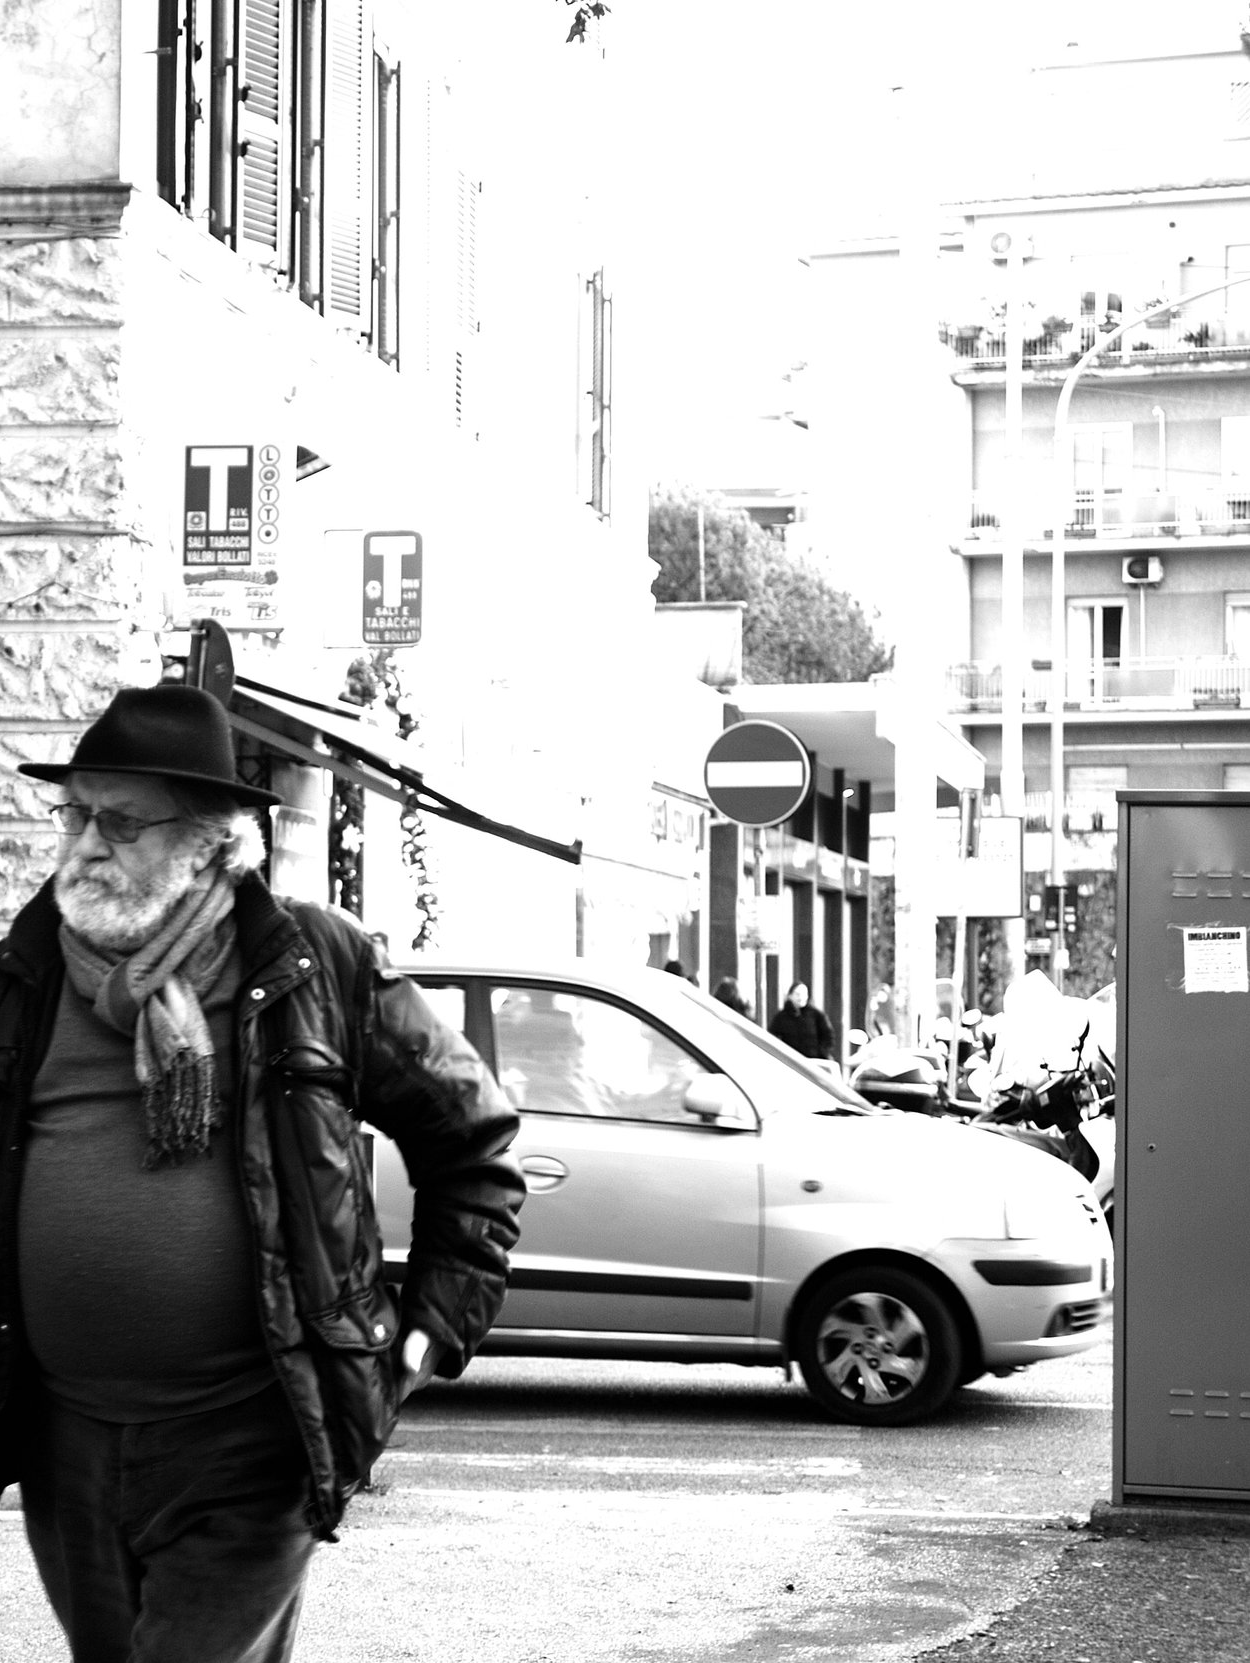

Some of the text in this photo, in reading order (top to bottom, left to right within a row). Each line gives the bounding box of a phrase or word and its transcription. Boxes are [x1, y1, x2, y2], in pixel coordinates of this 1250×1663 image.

[191, 448, 248, 531] T
[187, 536, 250, 549] SALI TABACCHI
[217, 551, 250, 563] BOLLATI
[369, 536, 417, 607] T
[210, 606, 232, 617] Tris
[375, 607, 409, 616] SALI E
[365, 617, 420, 628] TABACCHI
